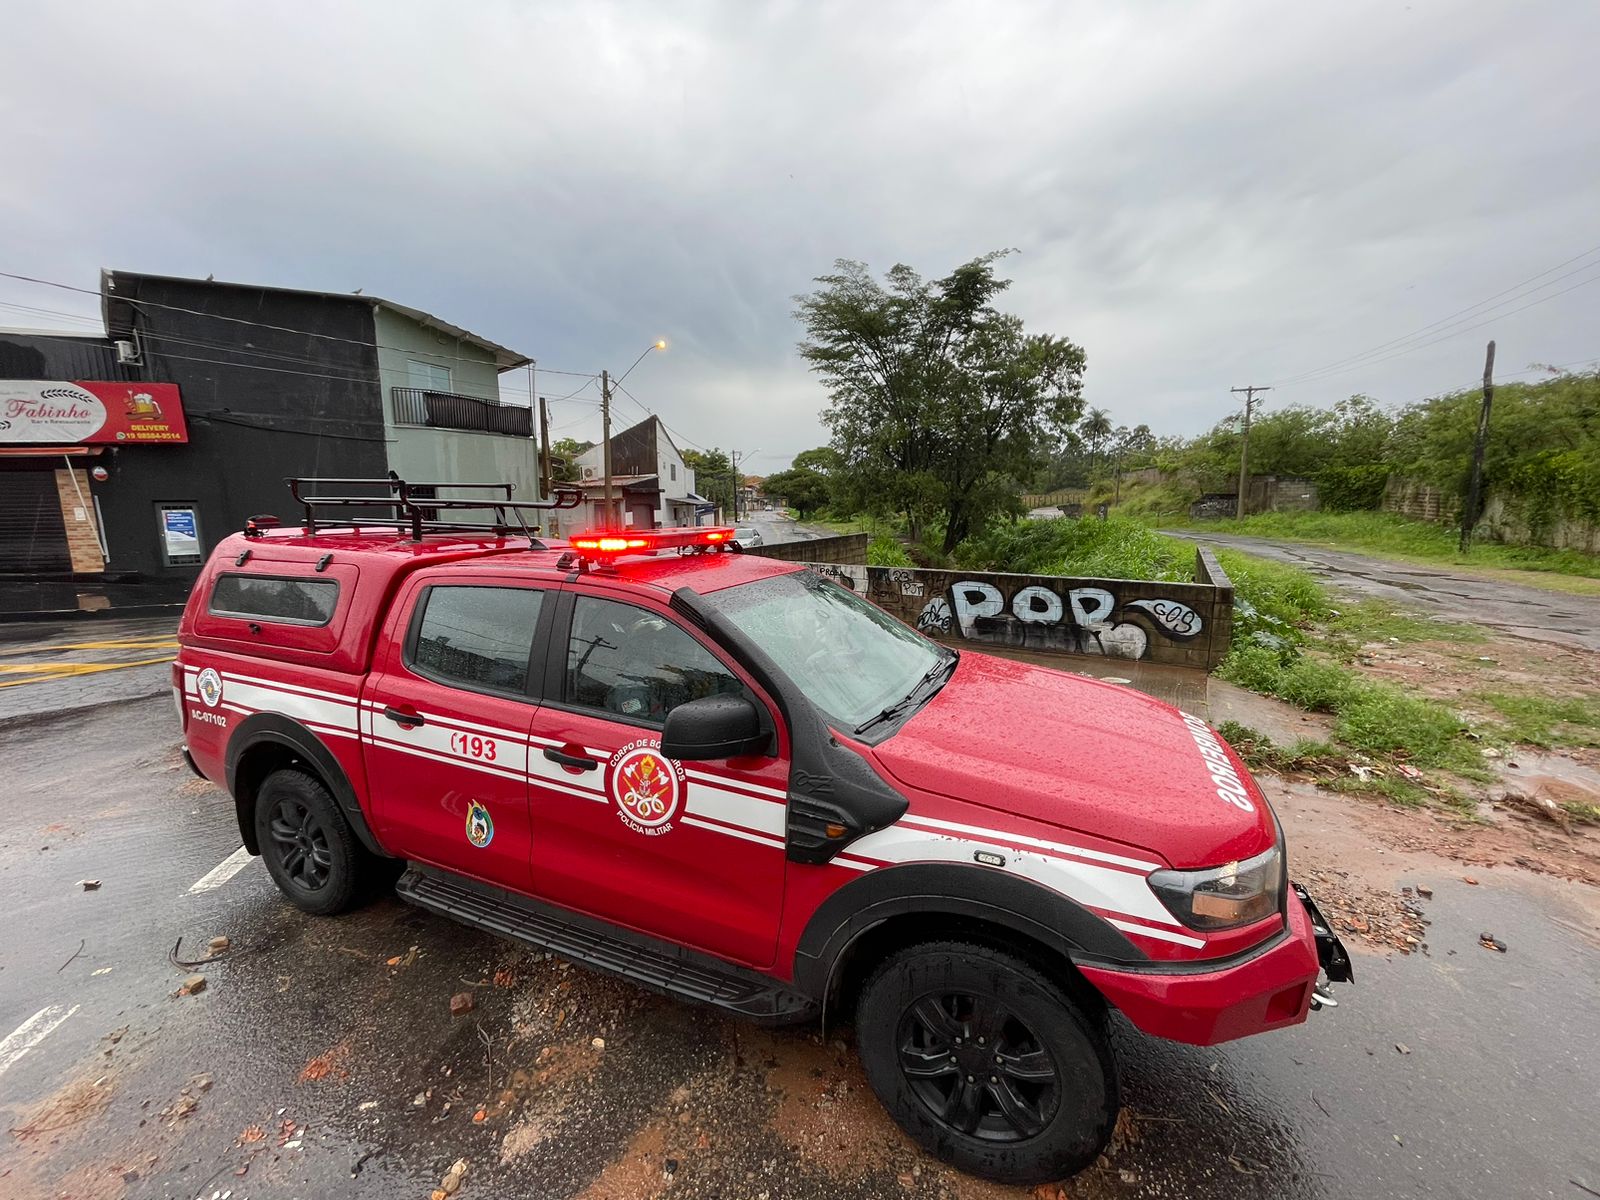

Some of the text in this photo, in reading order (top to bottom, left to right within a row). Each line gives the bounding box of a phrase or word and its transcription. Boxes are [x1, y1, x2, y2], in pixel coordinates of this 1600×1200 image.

[5, 398, 91, 418] Fabinho
[191, 709, 226, 727] AC-07102
[459, 734, 497, 761] 193
[610, 742, 635, 768] CORPO
[636, 739, 649, 747] DE
[645, 822, 674, 836] MILITAR
